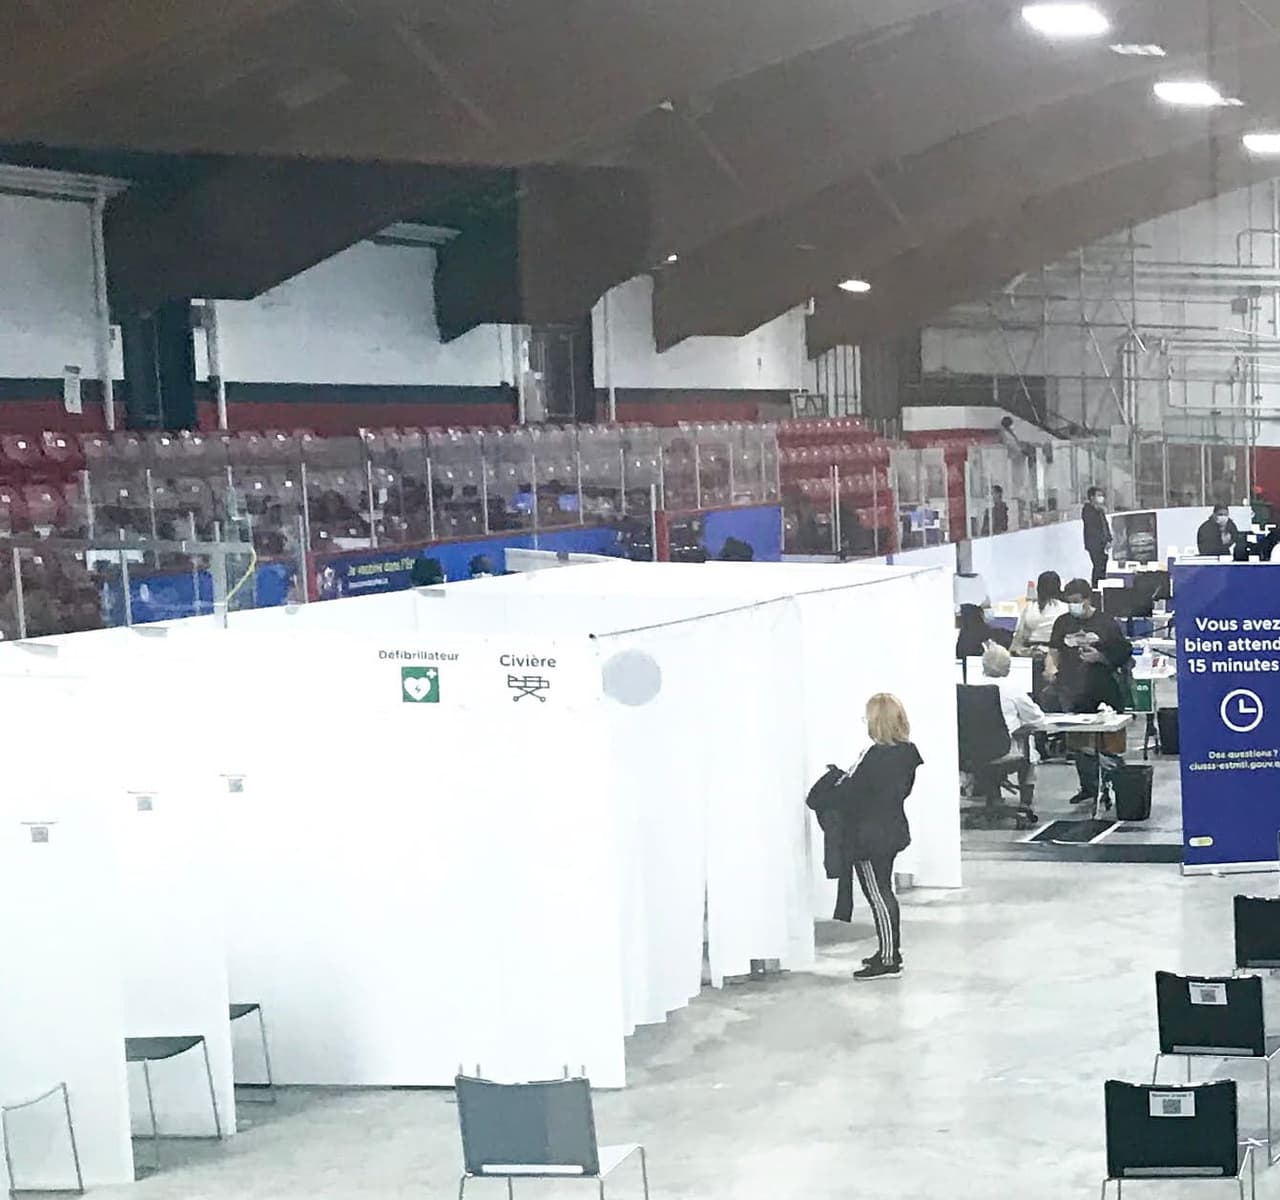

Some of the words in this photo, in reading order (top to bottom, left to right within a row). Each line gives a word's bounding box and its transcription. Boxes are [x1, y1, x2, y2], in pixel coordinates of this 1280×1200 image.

[1195, 617, 1238, 631] Vous
[1242, 619, 1280, 631] avez
[1184, 637, 1223, 652] bien
[378, 649, 459, 661] Défibrillateur
[499, 654, 557, 668] Civière
[1188, 659, 1207, 673] 15
[1212, 657, 1280, 672] minutes
[1227, 749, 1272, 760] questions
